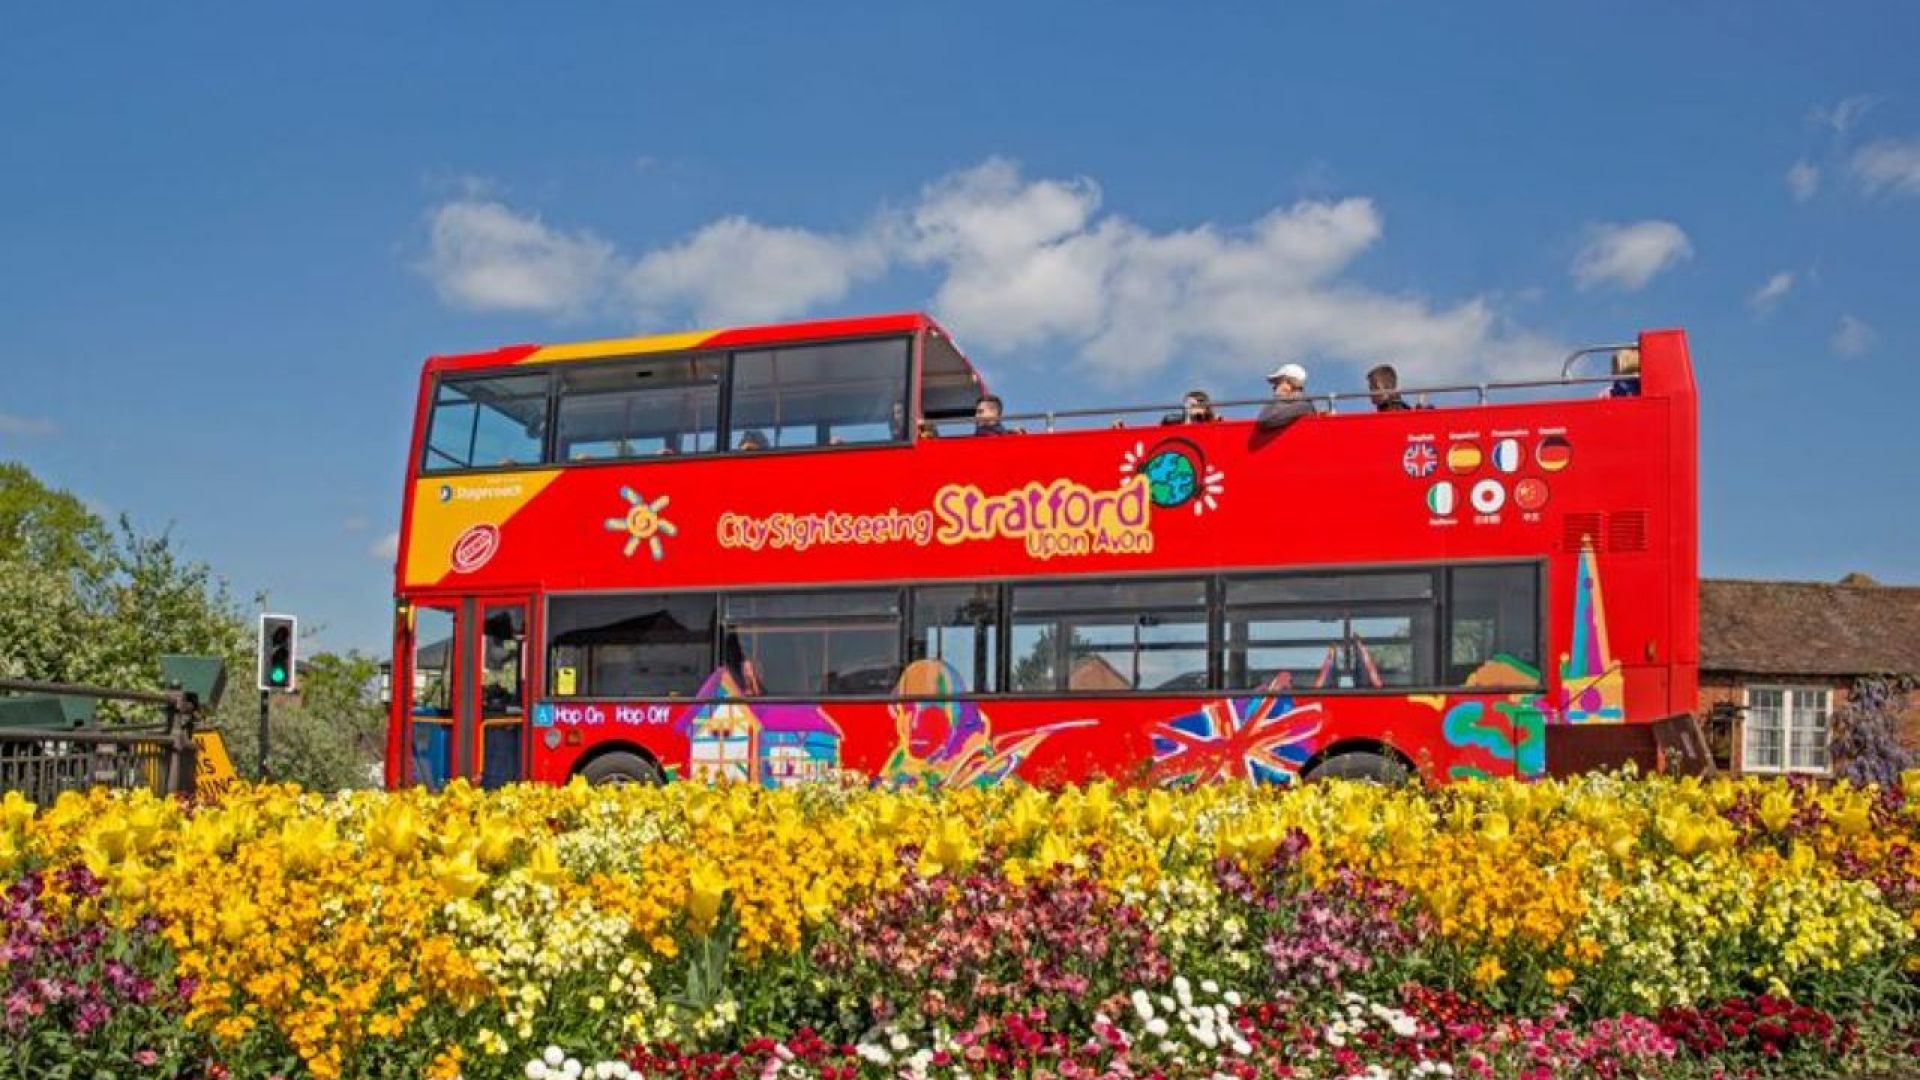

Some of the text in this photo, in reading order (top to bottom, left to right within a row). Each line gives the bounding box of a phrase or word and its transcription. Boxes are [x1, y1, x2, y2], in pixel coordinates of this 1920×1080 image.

[937, 476, 1146, 541] Stratford
[1093, 528, 1151, 553] Avon
[555, 705, 671, 724] Hop On Hop Off
